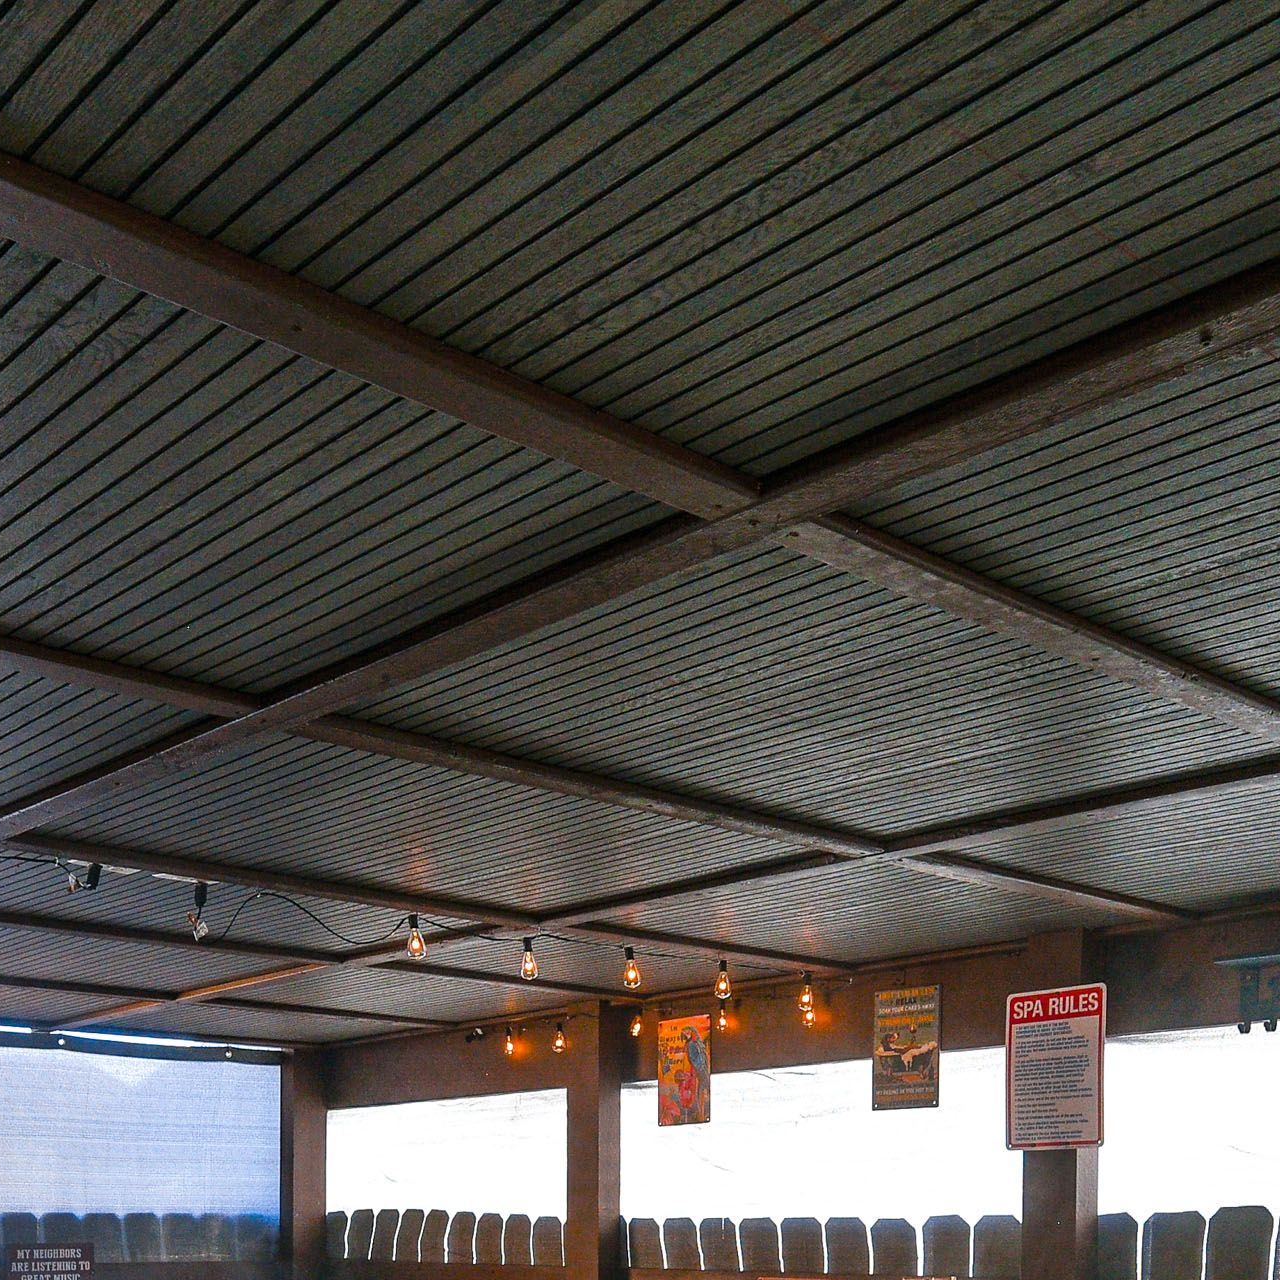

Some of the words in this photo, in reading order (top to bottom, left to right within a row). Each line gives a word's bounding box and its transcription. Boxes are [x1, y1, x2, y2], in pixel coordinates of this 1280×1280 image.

[1013, 998, 1044, 1020] SPA
[1048, 991, 1099, 1016] RULES
[17, 1249, 31, 1259] MY
[33, 1248, 82, 1259] NEIGHBORS
[11, 1262, 29, 1272] ARE
[32, 1261, 77, 1272] LISTENING
[79, 1260, 91, 1271] TO
